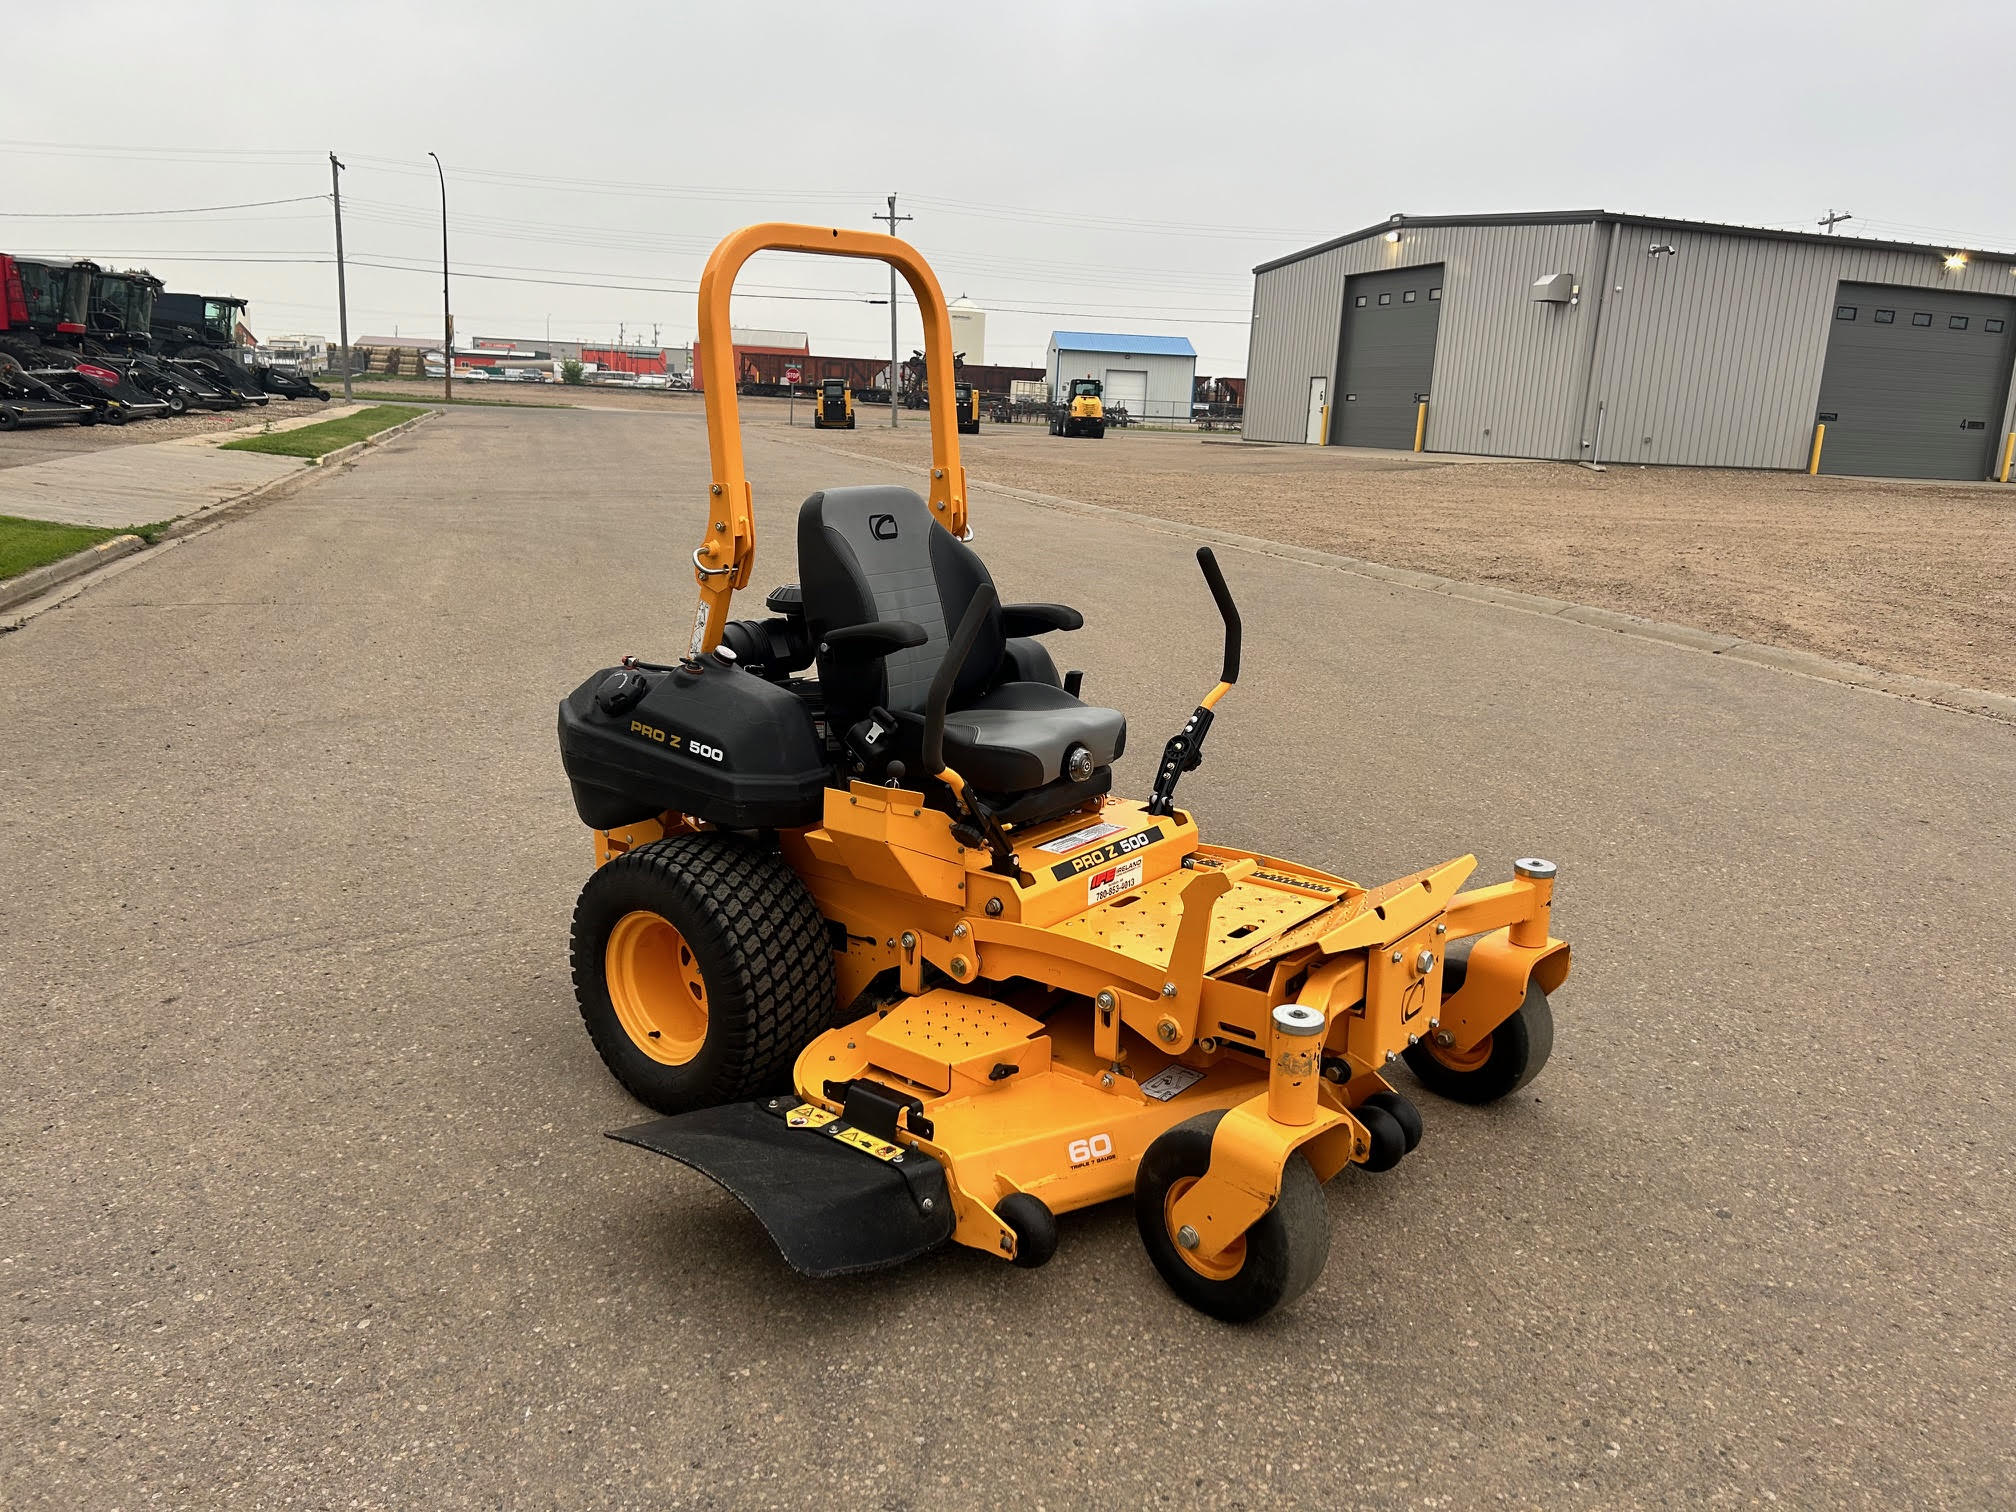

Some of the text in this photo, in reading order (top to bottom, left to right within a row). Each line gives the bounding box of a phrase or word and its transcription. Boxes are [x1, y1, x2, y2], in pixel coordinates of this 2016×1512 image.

[1959, 419, 1967, 431] 4
[630, 720, 724, 762] PRO Z 500
[1071, 850, 1105, 872] PRO
[1105, 845, 1118, 859] Z
[1119, 832, 1149, 853] 500
[1068, 1133, 1112, 1163] 60
[1070, 1161, 1090, 1170] TRIPLE
[1096, 1154, 1116, 1163] GAUGE
